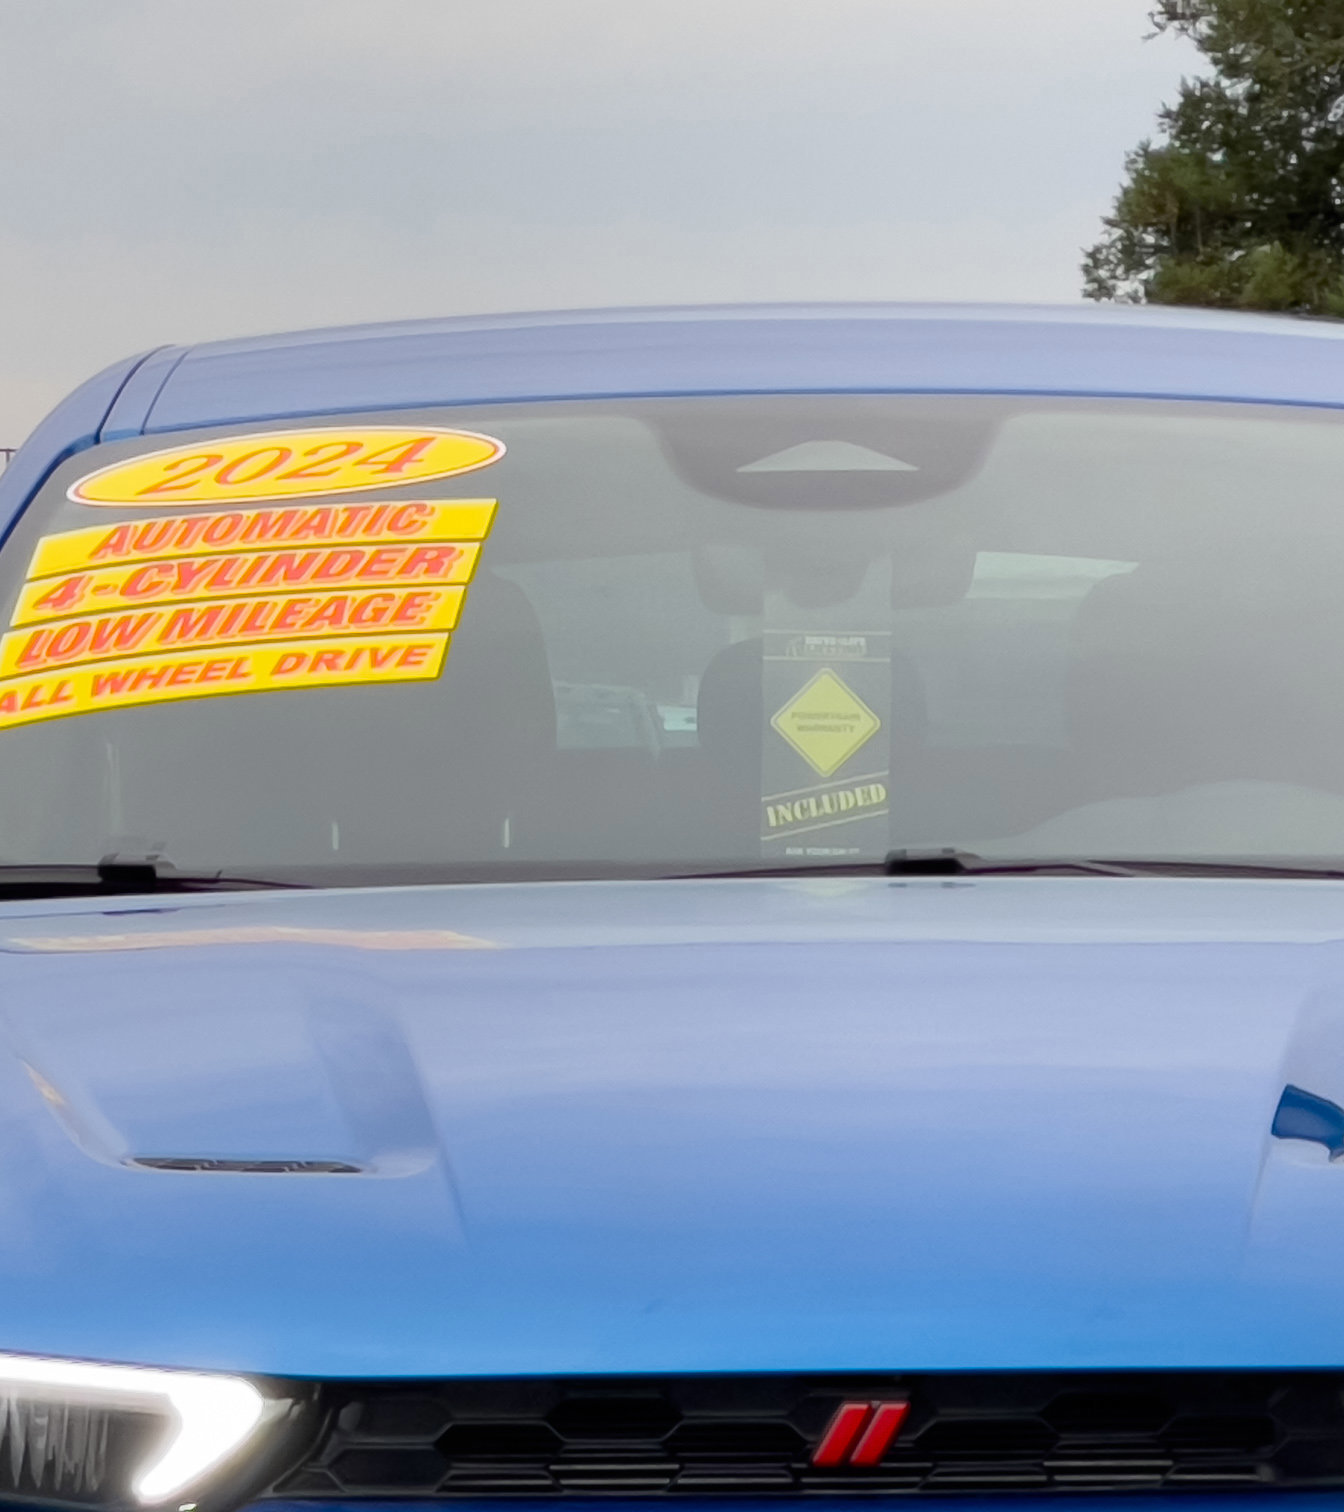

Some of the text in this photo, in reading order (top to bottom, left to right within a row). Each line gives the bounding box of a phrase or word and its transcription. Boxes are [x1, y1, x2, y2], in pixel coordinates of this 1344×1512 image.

[134, 436, 438, 496] 2024
[88, 501, 436, 561] AUTOMATIC
[32, 545, 464, 613] 4-CYLINDER
[15, 590, 440, 669] LOW MILEAGE
[90, 656, 254, 698] WHEEL
[269, 643, 435, 677] DRIVE
[766, 783, 887, 827] INCLUDED
